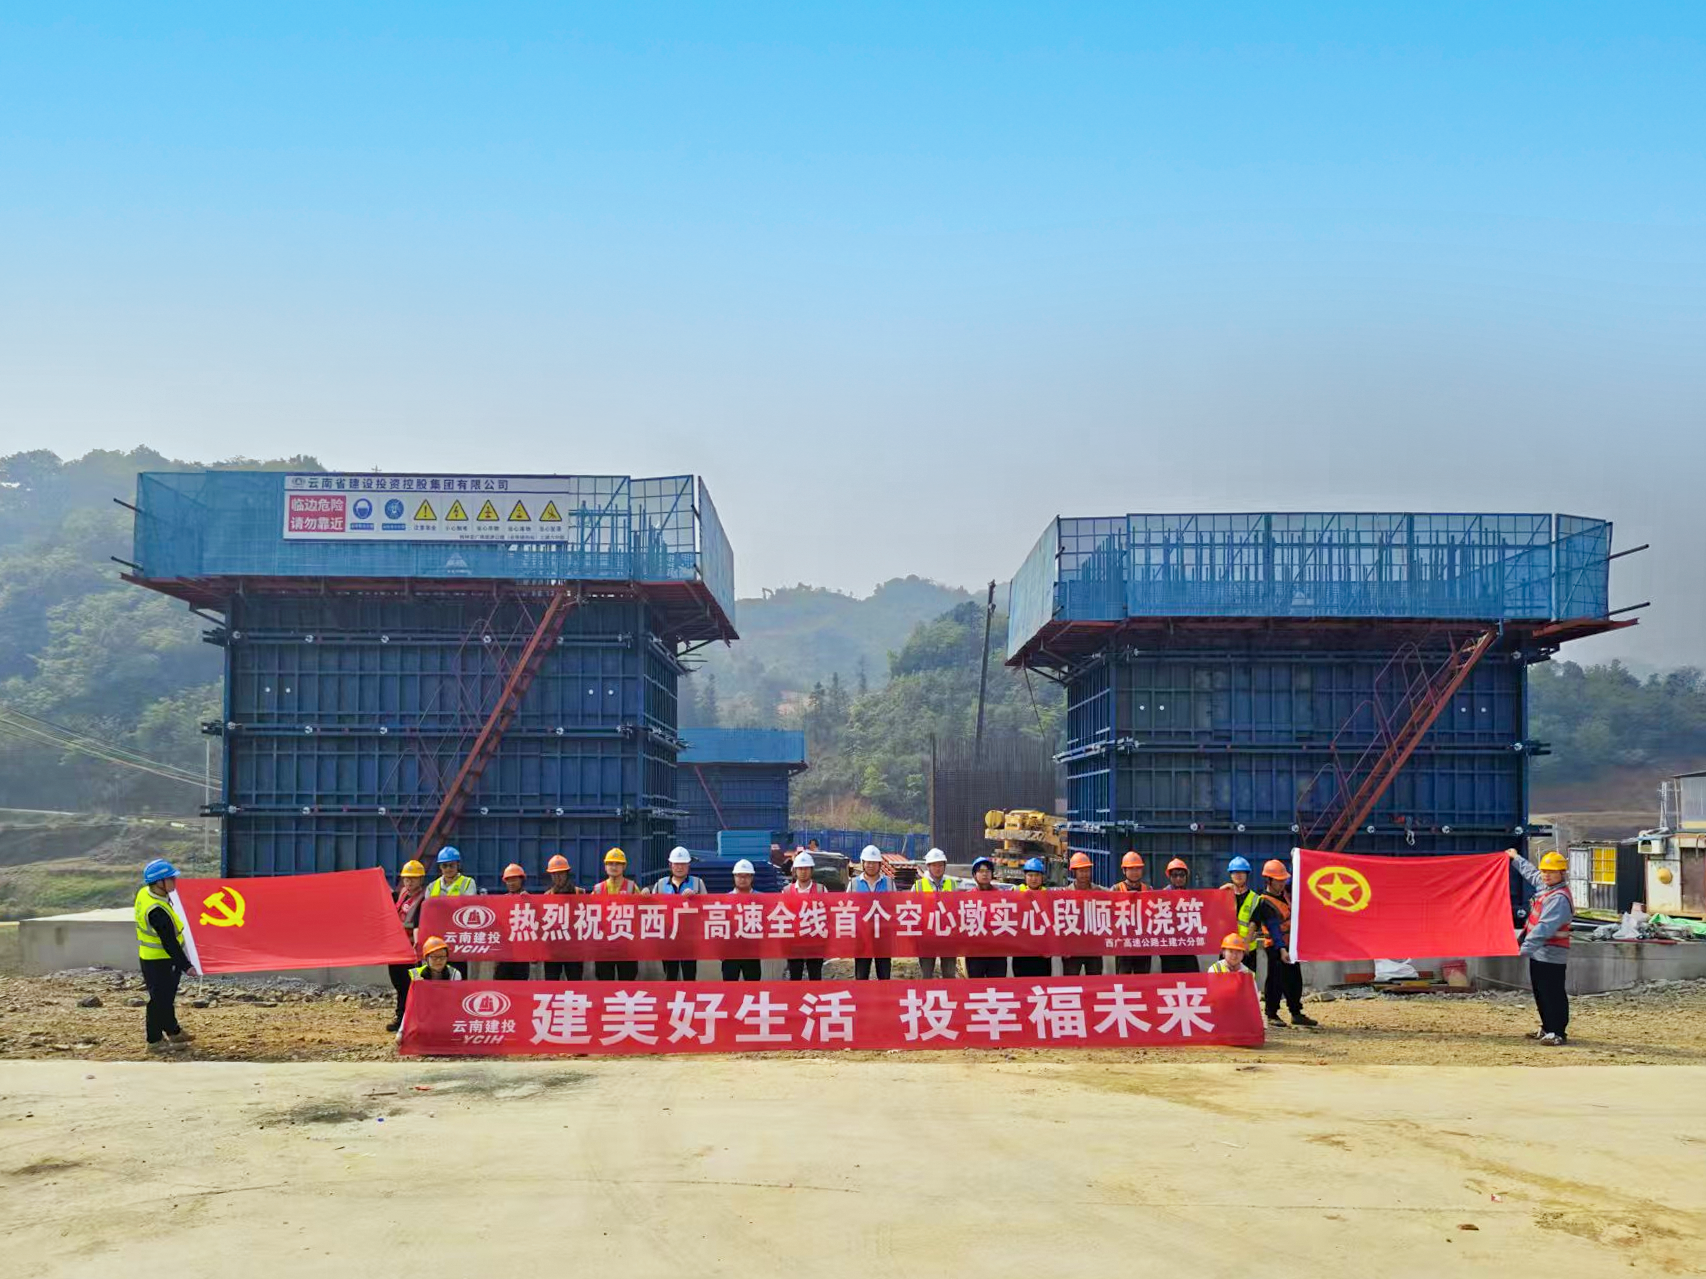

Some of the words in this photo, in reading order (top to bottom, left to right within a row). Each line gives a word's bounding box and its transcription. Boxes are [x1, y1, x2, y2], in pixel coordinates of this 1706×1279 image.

[308, 478, 509, 490] 云南省建设投资控股集团有限公司
[291, 498, 343, 511] 临边危险
[291, 517, 343, 530] 请勿靠近
[508, 897, 1208, 941] 热烈祝贺西广高速全线首个空心墩实心段顺利浇筑
[444, 931, 501, 944] 云南建投
[1105, 936, 1206, 948] 西广高速公路土建六分部
[453, 944, 491, 954] YCIH
[530, 990, 857, 1046] 建美好生活
[899, 981, 1215, 1041] 投幸福未来
[452, 1019, 516, 1034] 云南建投
[462, 1035, 505, 1045] YCIH
